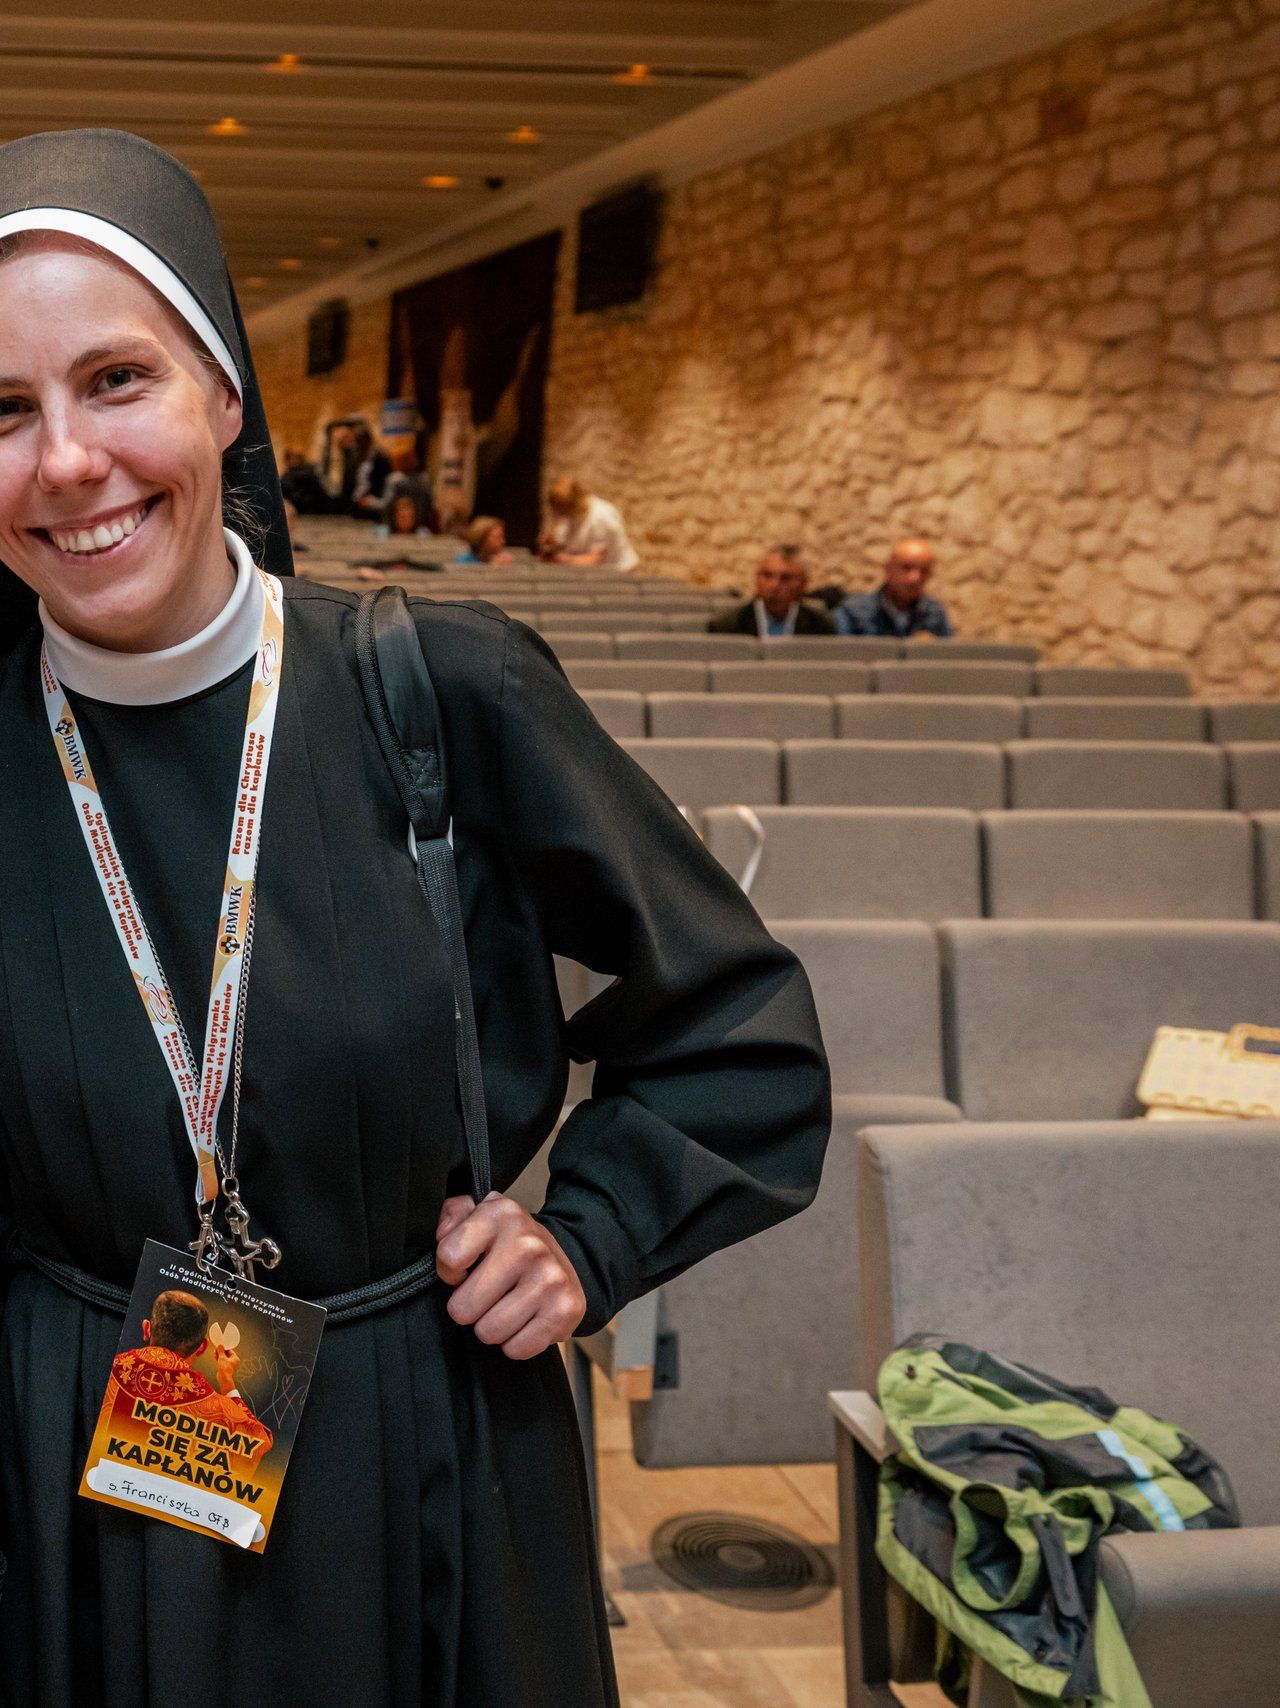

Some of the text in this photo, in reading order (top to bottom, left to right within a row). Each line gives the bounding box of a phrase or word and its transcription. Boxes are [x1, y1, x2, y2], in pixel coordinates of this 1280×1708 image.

[63, 734, 87, 781] BMWK
[232, 732, 256, 855] Razem dla Chrystusa
[243, 734, 266, 855] razem dla kapłanów
[82, 802, 140, 960] Osób Modlących się za Kapłanów
[95, 812, 142, 941] Ogólnopolska Pielgrzymka
[225, 886, 243, 935] BMWK
[220, 983, 233, 1034] Kapłanów
[171, 1031, 194, 1091] Razem dla
[200, 1000, 220, 1134] Ogólnopolska Pielgrzymka
[217, 1051, 226, 1066] się
[220, 1037, 227, 1050] za
[163, 1035, 180, 1071] razem
[177, 1074, 186, 1093] dla
[185, 1096, 199, 1142] kapłan
[208, 1068, 223, 1118] Modlących
[159, 1268, 294, 1324] Osób Modlących się za Kapłanów
[236, 1289, 285, 1314] Pielgrzymka
[132, 1398, 262, 1457] MODLIMY
[148, 1428, 230, 1471] SIĘ ZA
[106, 1437, 265, 1504] KAPŁANÓW
